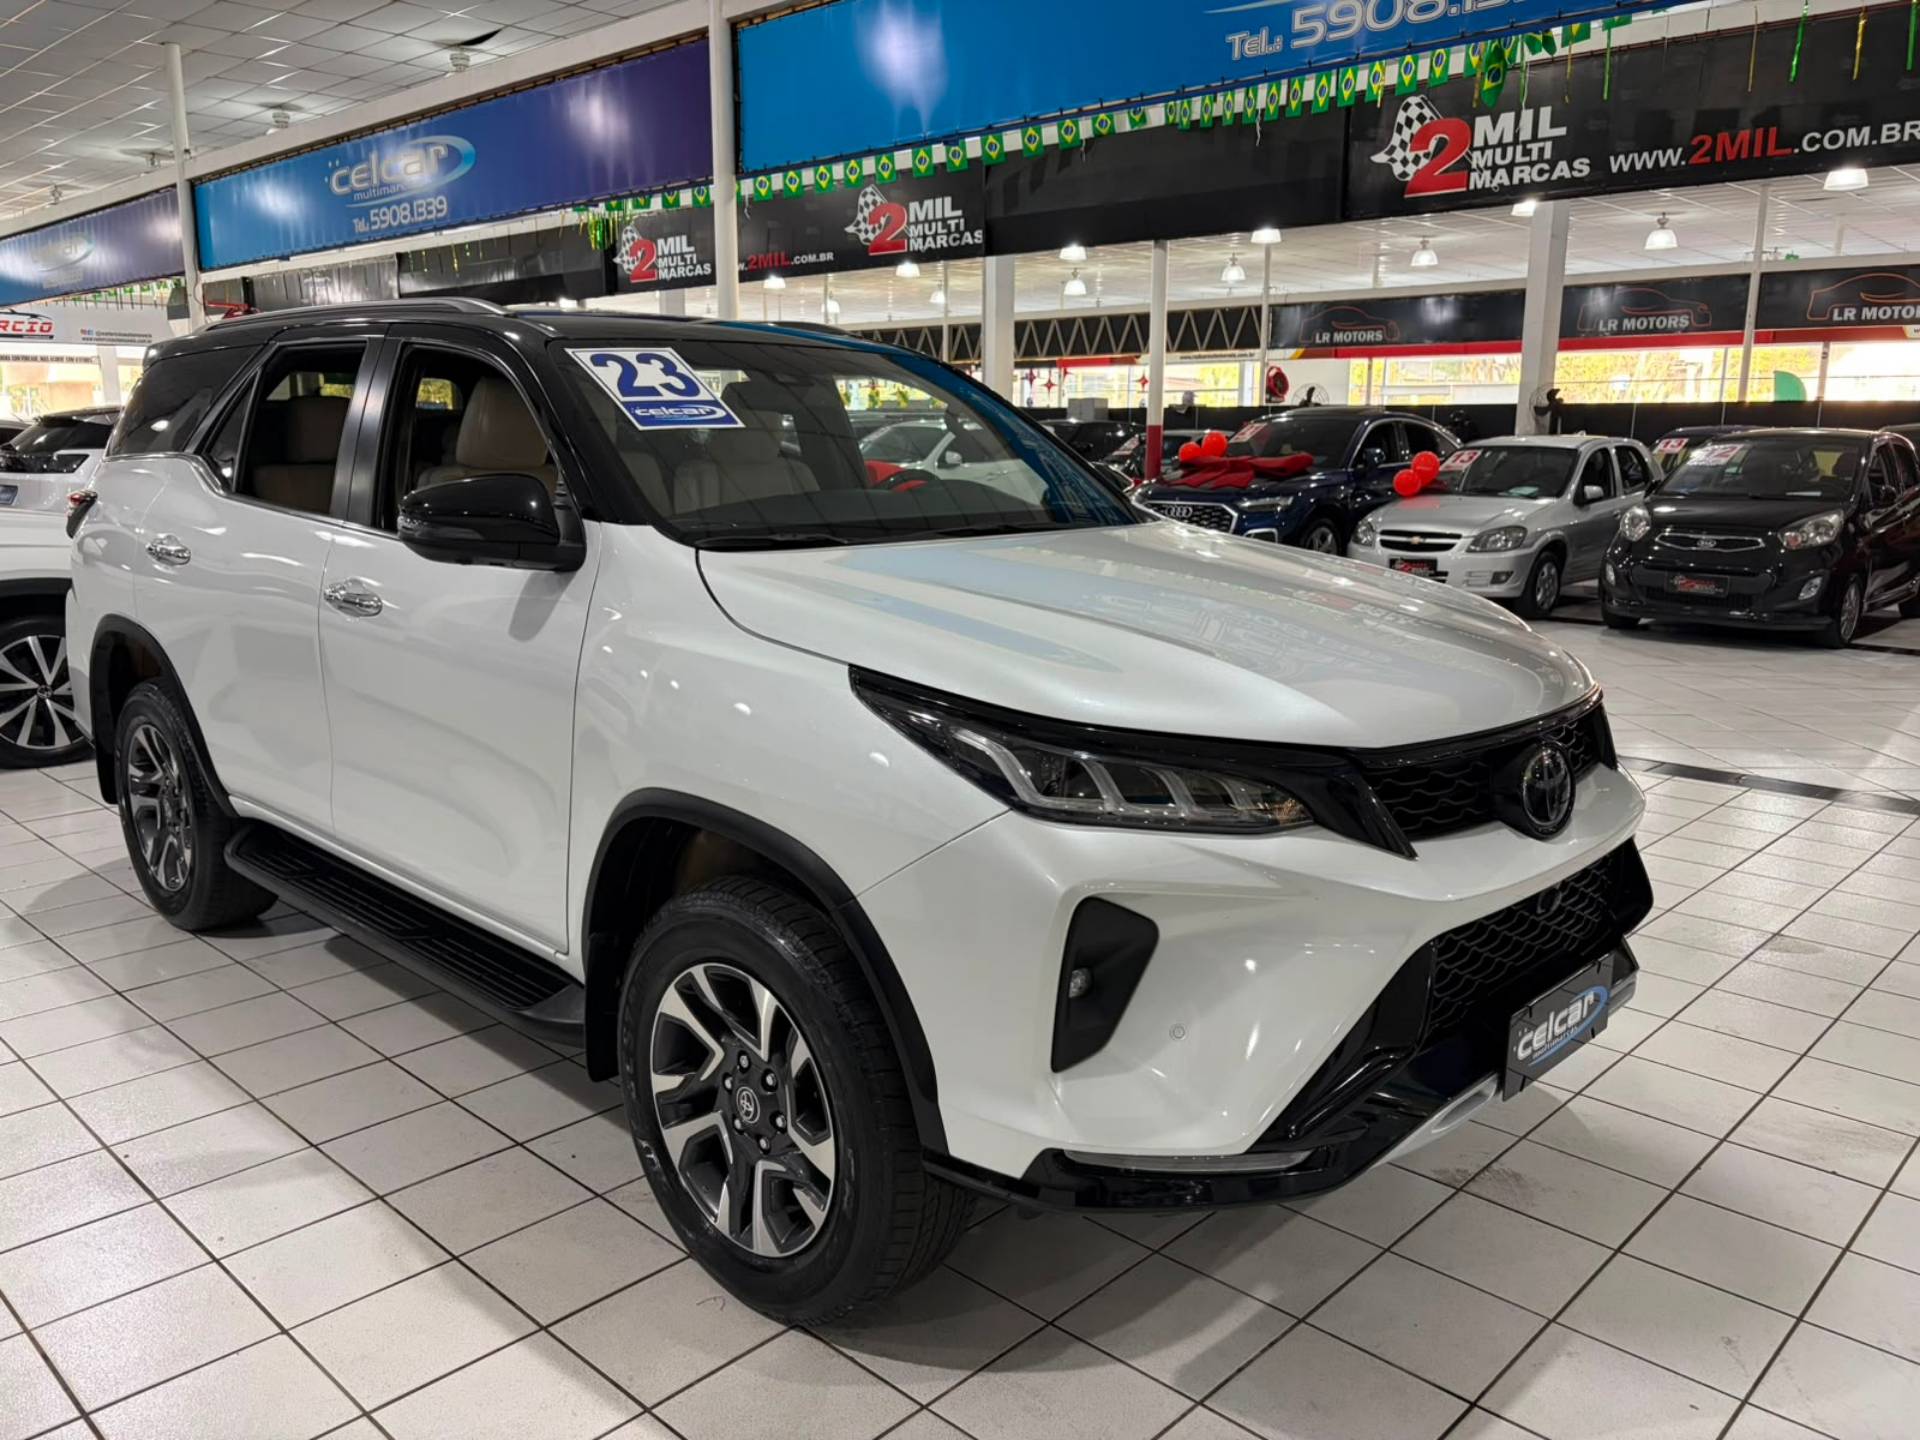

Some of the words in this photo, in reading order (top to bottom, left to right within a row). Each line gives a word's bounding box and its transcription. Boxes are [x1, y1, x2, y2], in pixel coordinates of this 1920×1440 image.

[1404, 117, 1473, 198] 2
[1472, 106, 1568, 148] MIL
[1471, 140, 1553, 169] MULTI
[1609, 120, 1920, 174] WWW.2MIL.COM.BR
[331, 143, 448, 195] celcar
[1468, 157, 1591, 191] MARCAS
[370, 195, 447, 231] 5908.1339
[868, 203, 908, 255] 2
[908, 196, 963, 223] MIL
[909, 218, 965, 238] MULTI
[909, 229, 983, 253] MARCAS
[630, 238, 657, 283] 2
[656, 235, 695, 256] MIL
[658, 253, 697, 269] MULTI
[658, 263, 712, 282] MARCAS
[1599, 319, 1618, 332] LR
[1622, 314, 1690, 331] MOTORS
[1833, 307, 1857, 321] LR
[1315, 332, 1331, 344] LR
[1333, 330, 1383, 344] MOTORS
[590, 353, 701, 398] 23
[635, 406, 712, 416] celcar
[1517, 991, 1595, 1061] celcar
